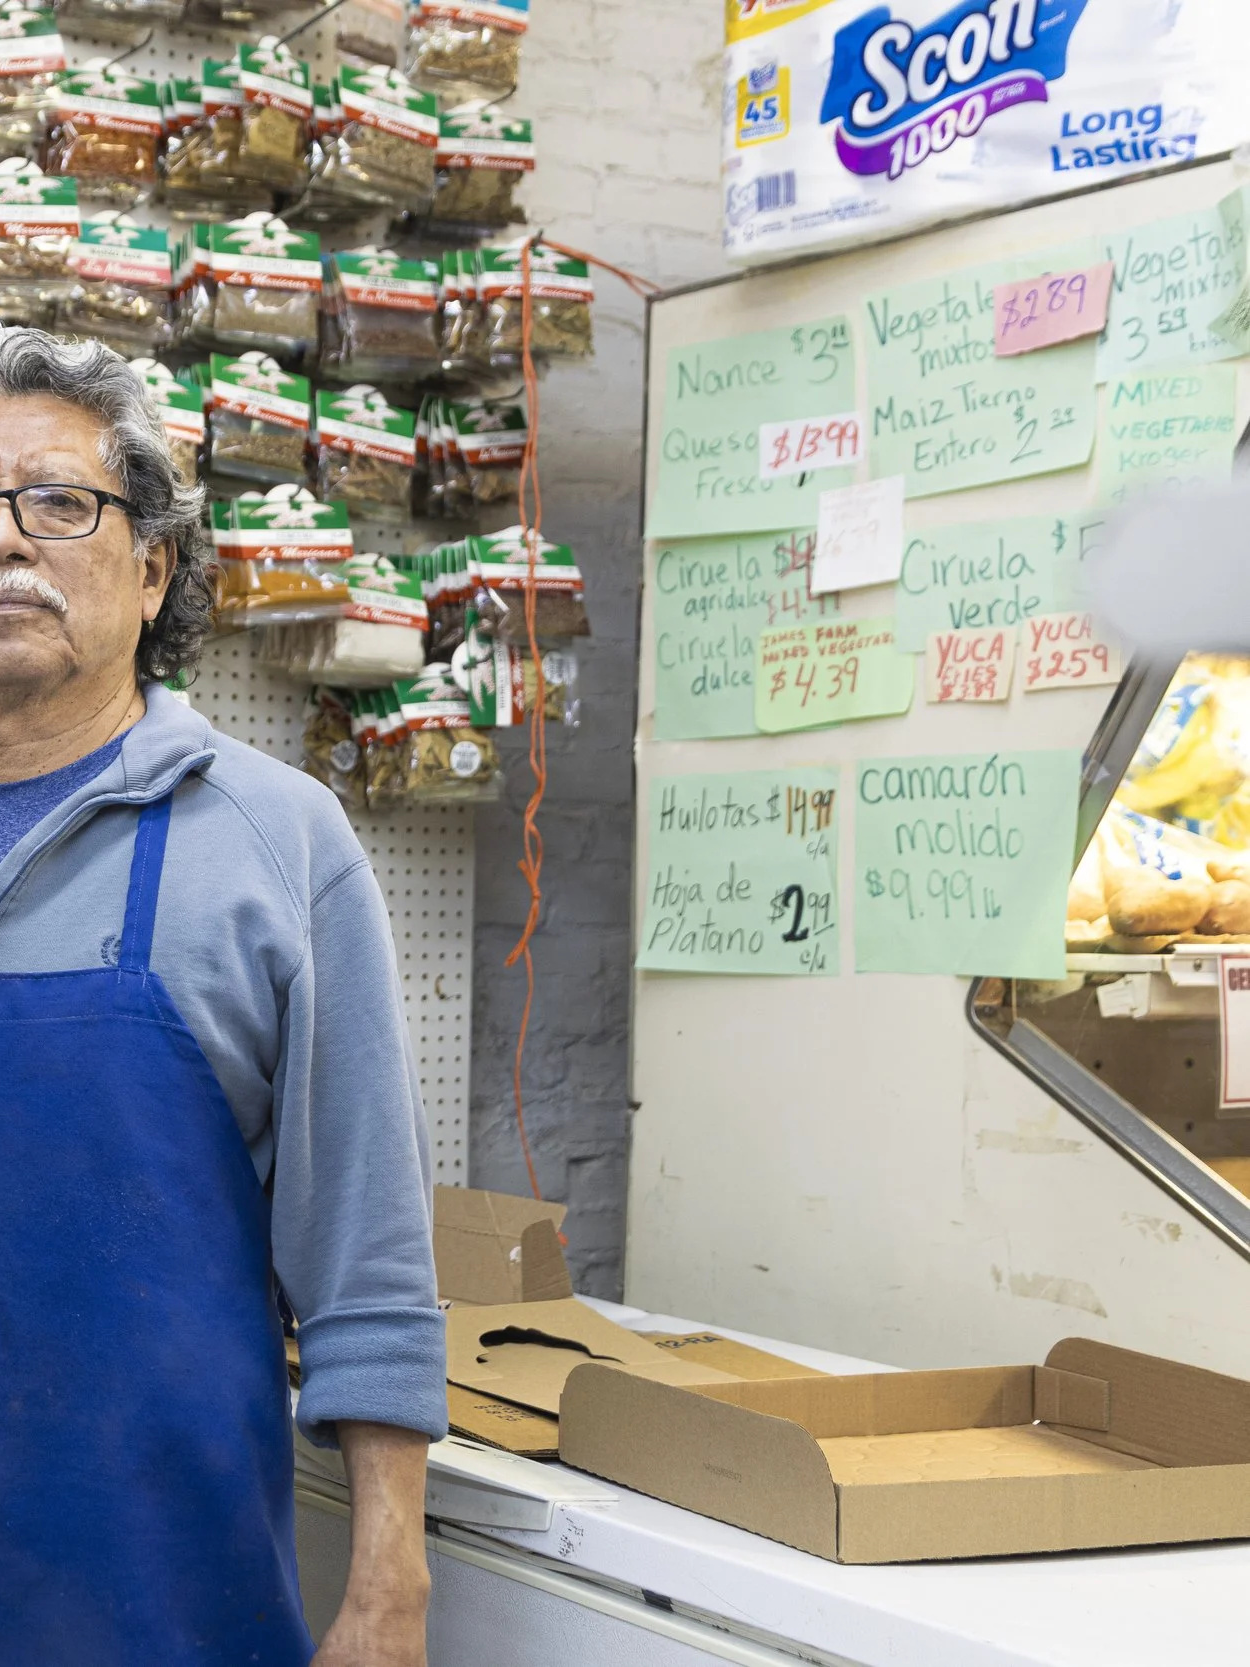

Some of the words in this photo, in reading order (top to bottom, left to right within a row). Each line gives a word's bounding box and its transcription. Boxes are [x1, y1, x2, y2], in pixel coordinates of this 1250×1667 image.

[851, 0, 1037, 128] Scott
[743, 96, 778, 125] 45
[1061, 104, 1163, 139] Long
[888, 95, 987, 180] 1000
[1052, 133, 1197, 173] Lasting
[677, 354, 782, 399] Nance
[1112, 377, 1204, 408] MIXED
[874, 396, 954, 436] Maiz
[952, 381, 1037, 413] Tierno
[663, 427, 759, 462] Queso
[914, 431, 997, 472] Entero
[656, 543, 761, 593] Ciruela
[900, 537, 1035, 595] Ciruela
[949, 584, 1041, 629] verde
[656, 624, 754, 669] Ciruela
[762, 630, 807, 649] JAMES
[815, 625, 858, 642] FARM
[936, 632, 1004, 678] YUCA
[1030, 613, 1092, 652] YUCA
[690, 662, 753, 696] dulce
[860, 754, 1026, 804] camarón
[659, 785, 761, 834] Huilotas
[895, 808, 1024, 859] molido
[652, 867, 703, 908] Hoja
[716, 861, 752, 900] de
[647, 908, 764, 955] Platano
